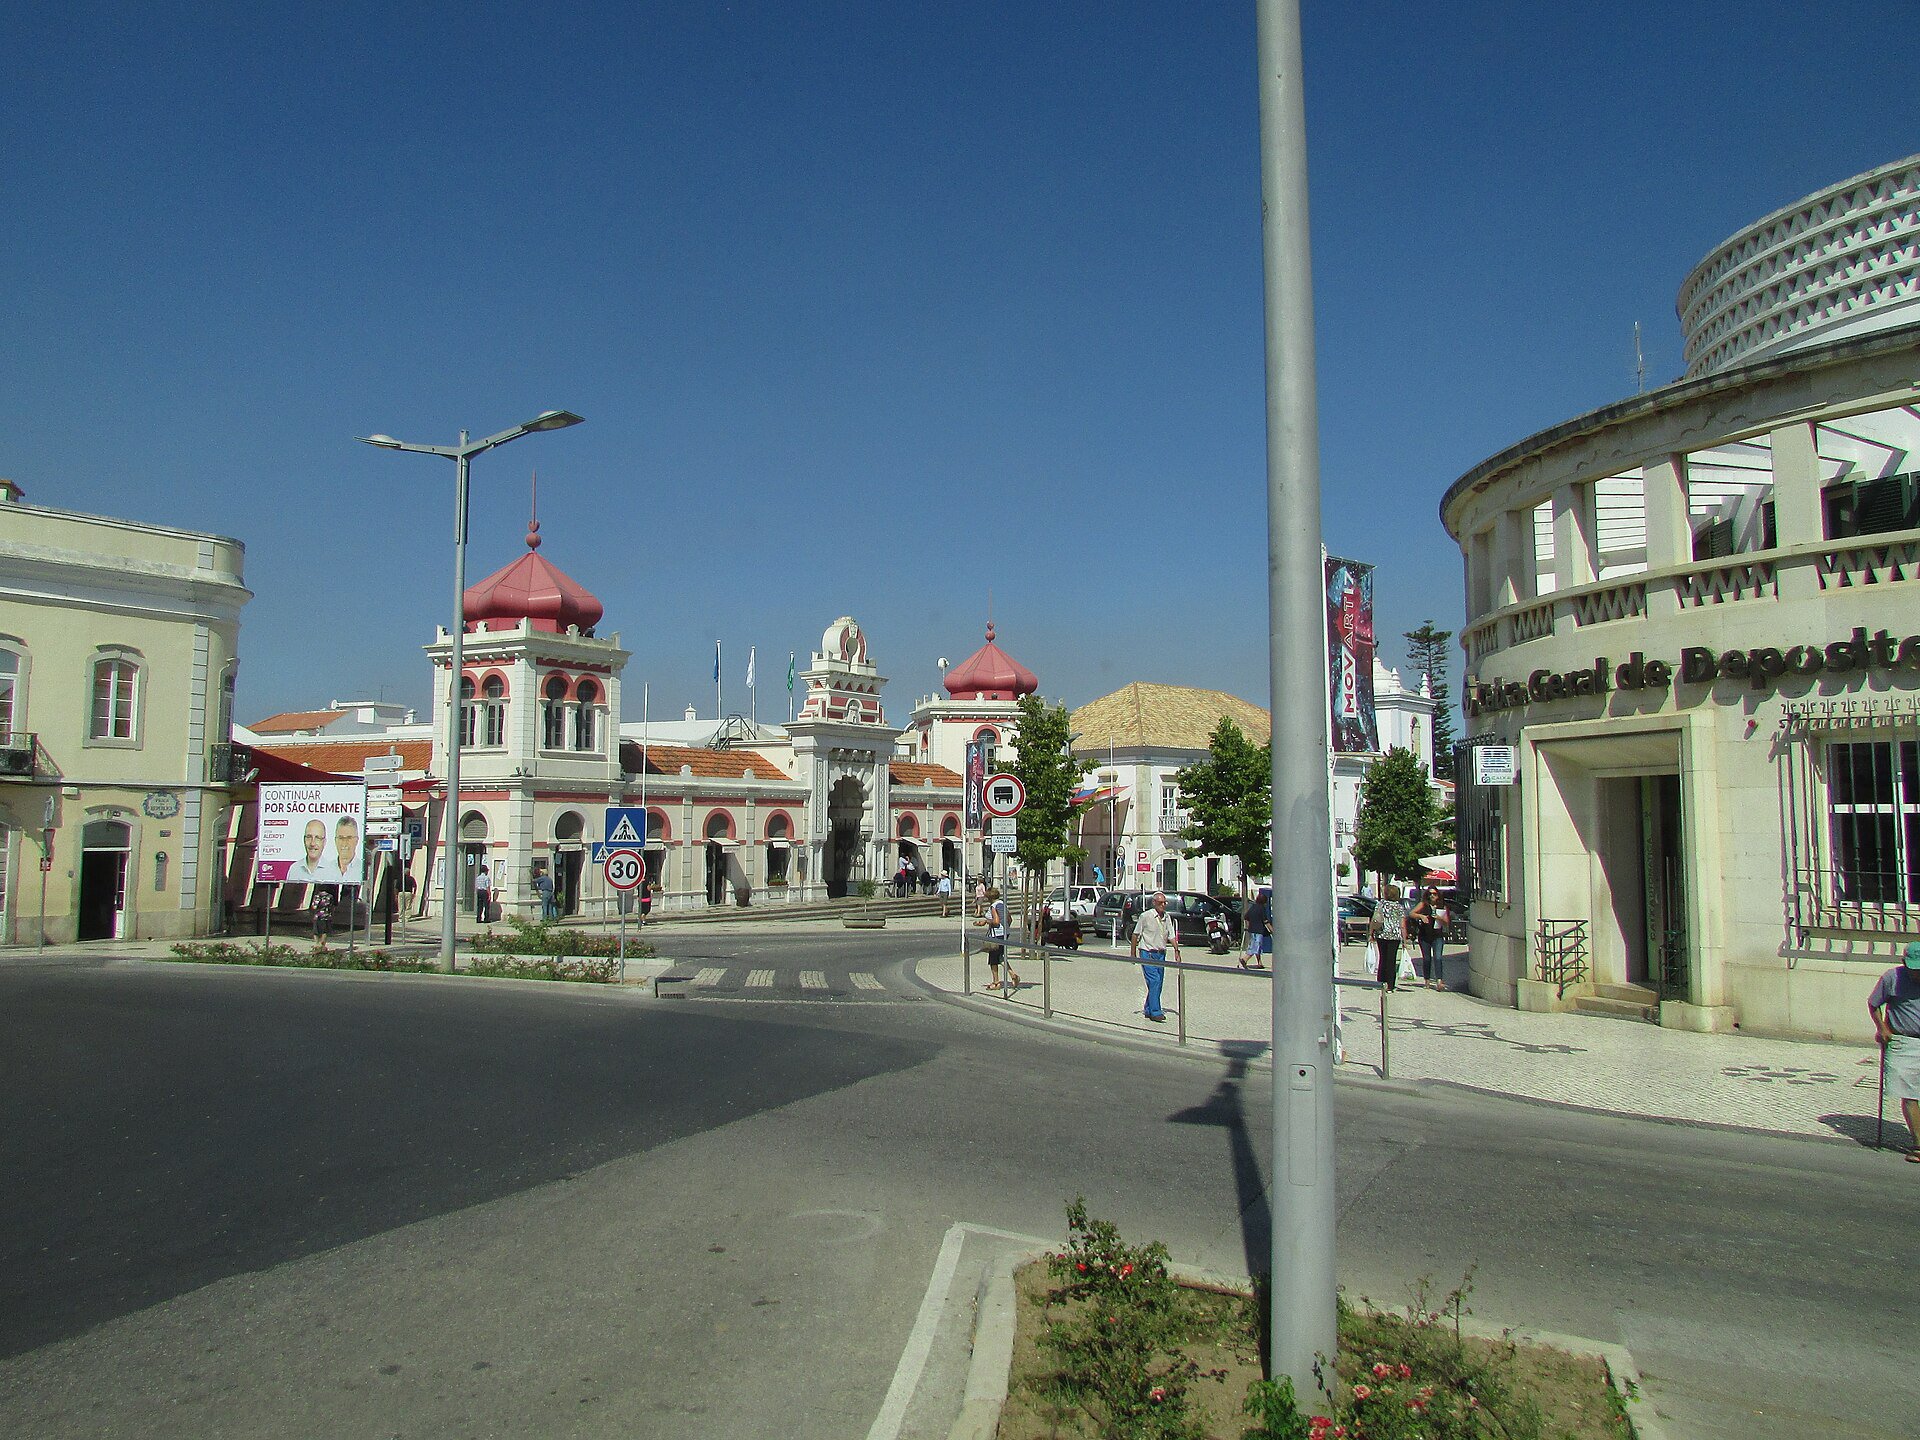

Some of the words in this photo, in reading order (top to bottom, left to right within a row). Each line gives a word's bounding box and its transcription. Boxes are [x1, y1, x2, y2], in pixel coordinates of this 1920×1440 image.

[1527, 656, 1608, 703] Geral
[1616, 651, 1672, 690] de
[264, 790, 321, 801] CONTINUAR
[264, 803, 285, 813] POR
[286, 801, 306, 813] SÃO
[308, 803, 360, 813] CLEMENTE
[1138, 851, 1147, 862] P
[611, 859, 639, 879] 30
